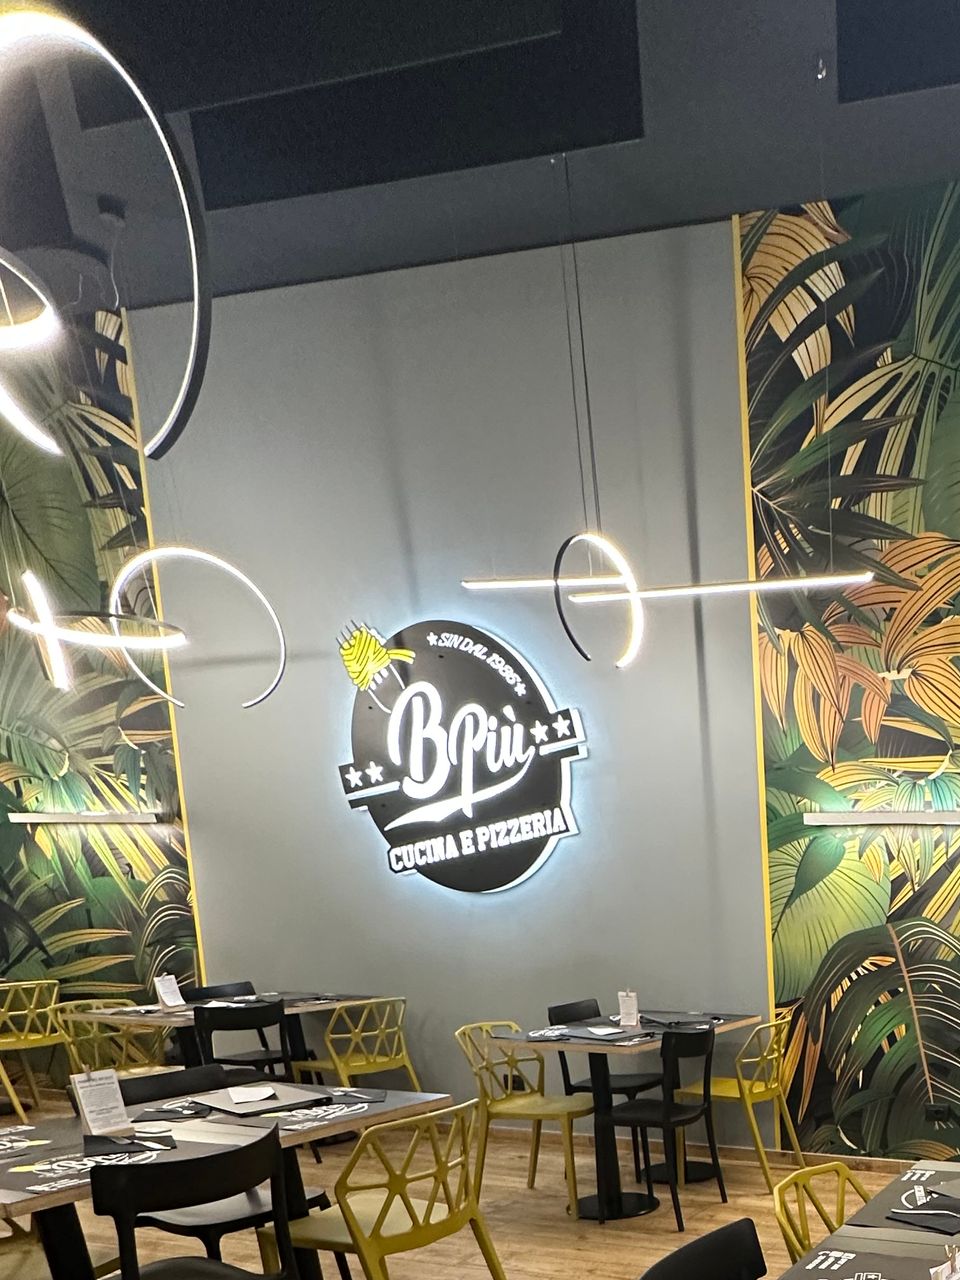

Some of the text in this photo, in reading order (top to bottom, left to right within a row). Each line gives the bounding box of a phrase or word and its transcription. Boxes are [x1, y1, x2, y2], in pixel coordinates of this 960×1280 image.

[459, 639, 488, 660] DAL
[486, 652, 522, 685] 1986
[389, 807, 567, 872] CUCINA E PIZZERIA
